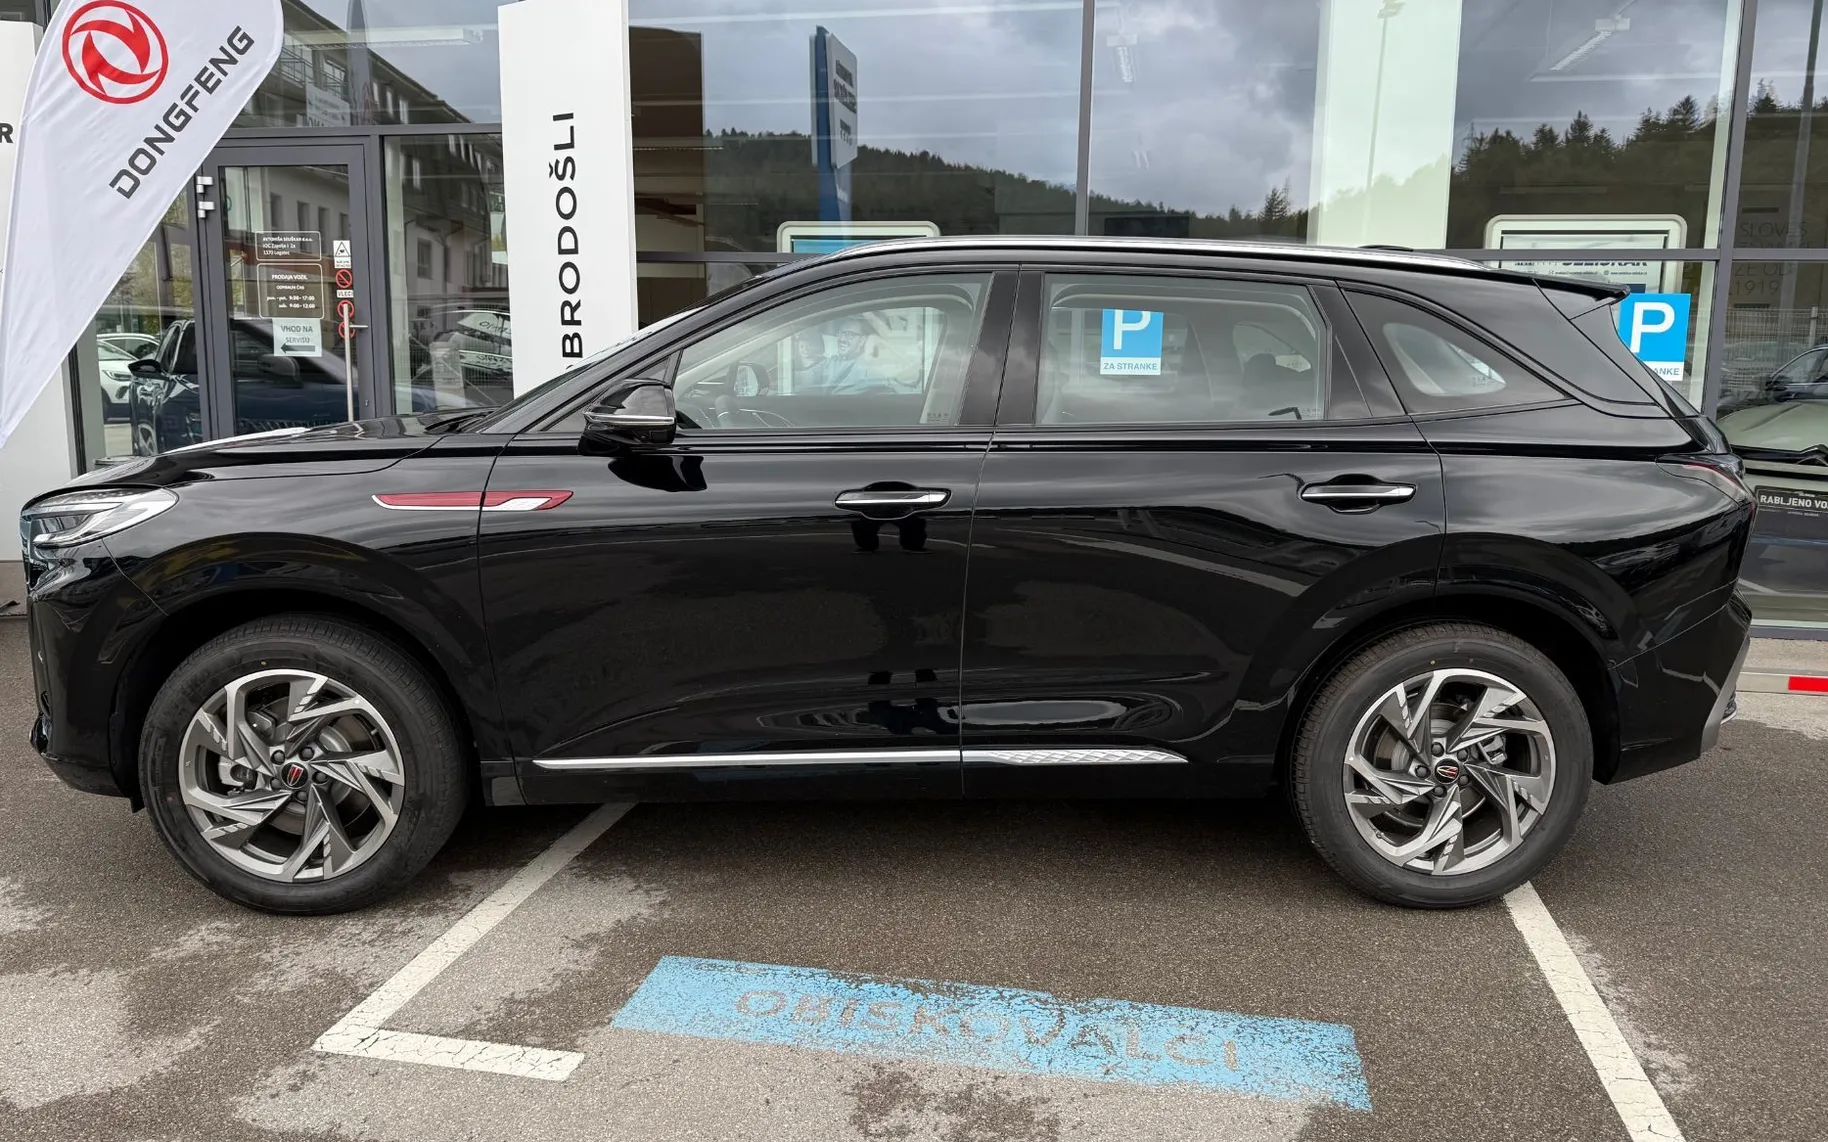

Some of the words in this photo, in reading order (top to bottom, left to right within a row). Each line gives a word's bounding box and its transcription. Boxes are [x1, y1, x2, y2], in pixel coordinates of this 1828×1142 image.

[109, 25, 255, 199] DONGFENG
[549, 112, 583, 369] BRODOŠLI
[280, 325, 301, 333] VHOD
[302, 325, 314, 333] NA
[1113, 309, 1152, 350] P
[1630, 302, 1676, 354] P
[1103, 362, 1115, 370] ZA
[1117, 362, 1158, 371] STRANKE
[1653, 367, 1680, 376] ANKE
[1760, 494, 1812, 508] RABLJENO
[1814, 499, 1828, 510] VO
[735, 989, 1239, 1072] OBISKOVALCI
